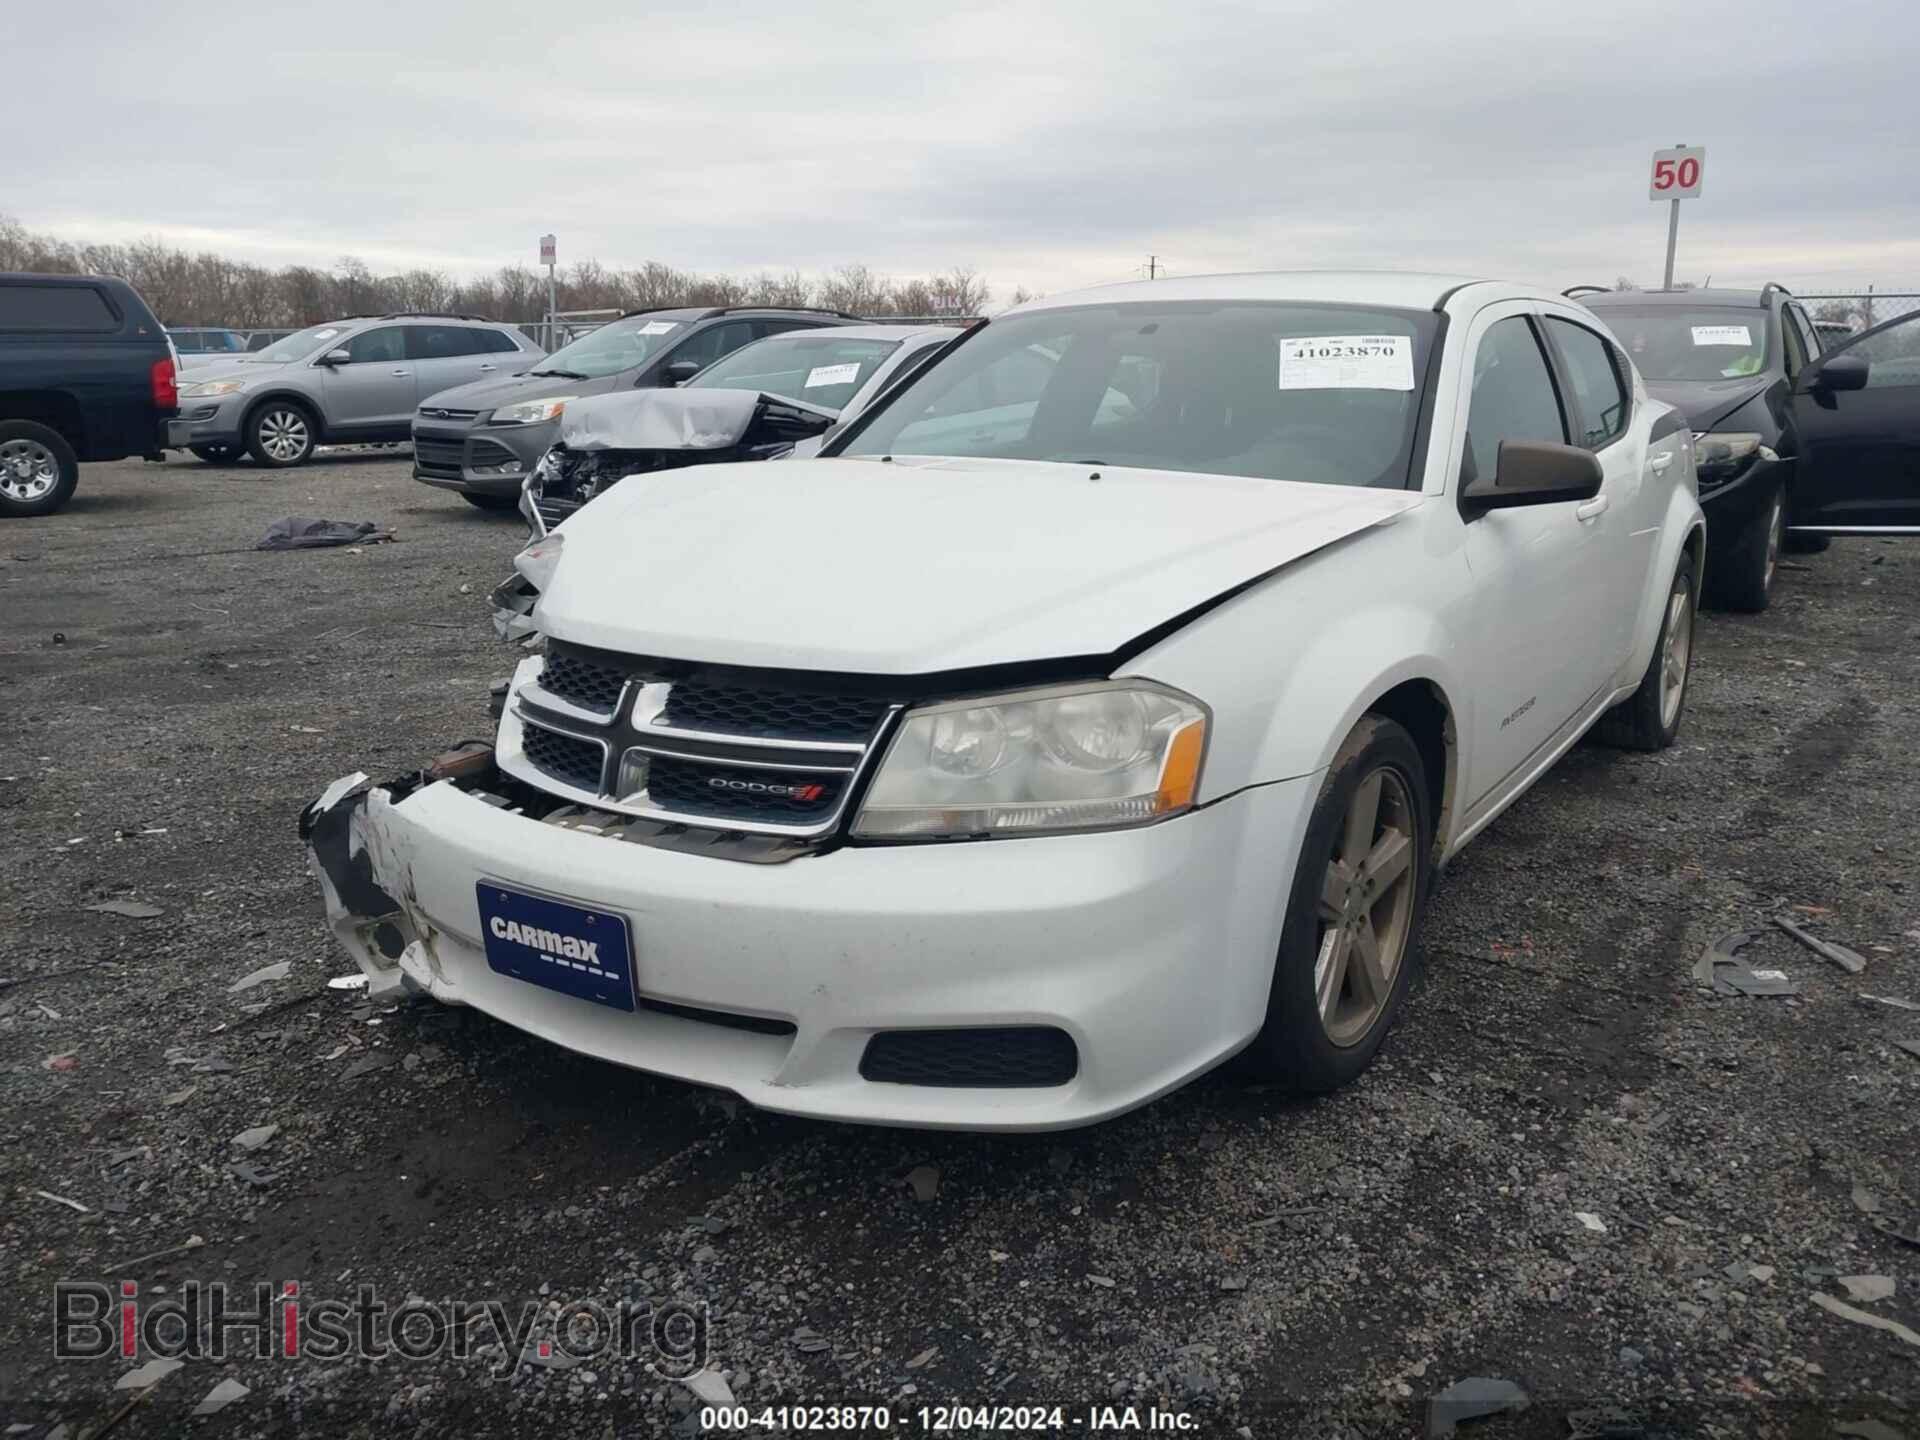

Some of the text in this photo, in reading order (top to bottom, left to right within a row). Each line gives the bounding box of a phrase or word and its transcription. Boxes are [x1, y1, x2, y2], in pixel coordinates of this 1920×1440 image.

[1654, 158, 1700, 190] 50
[1294, 346, 1395, 358] 41023870
[708, 777, 802, 797] DODGE
